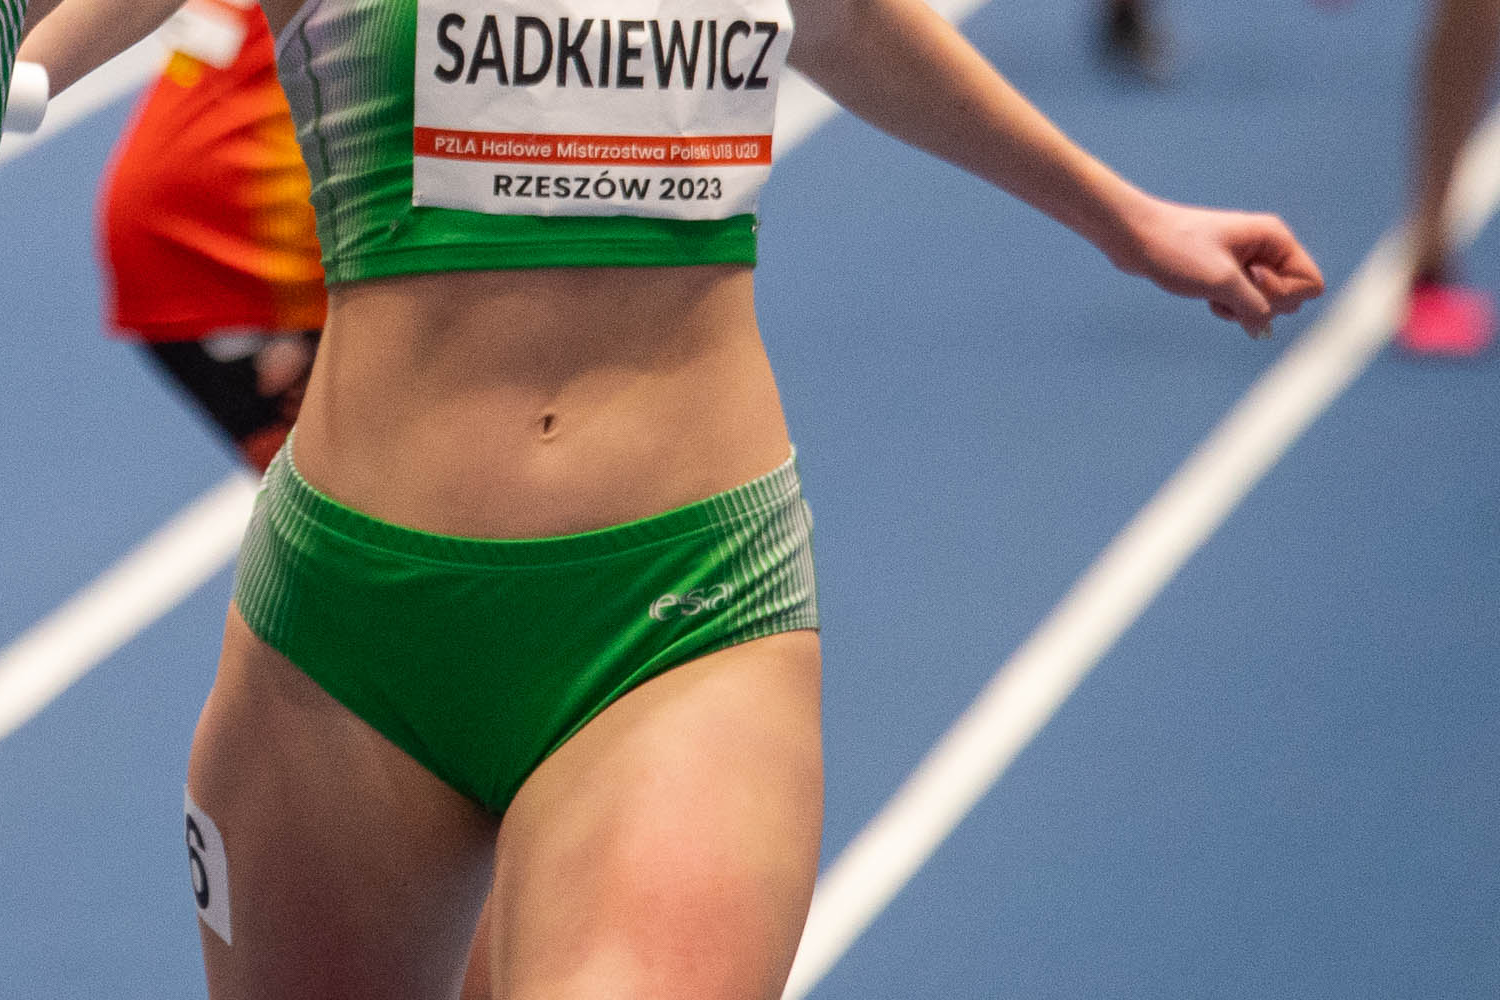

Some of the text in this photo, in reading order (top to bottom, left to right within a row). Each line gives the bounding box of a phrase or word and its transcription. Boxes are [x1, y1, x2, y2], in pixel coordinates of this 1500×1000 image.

[433, 12, 780, 91] SADKIEWICZ
[434, 136, 760, 161] PZLA Halowe Mistrzostwa Polski U18 U20
[493, 169, 723, 201] RZESZÓW 2023
[185, 813, 210, 910] 6
